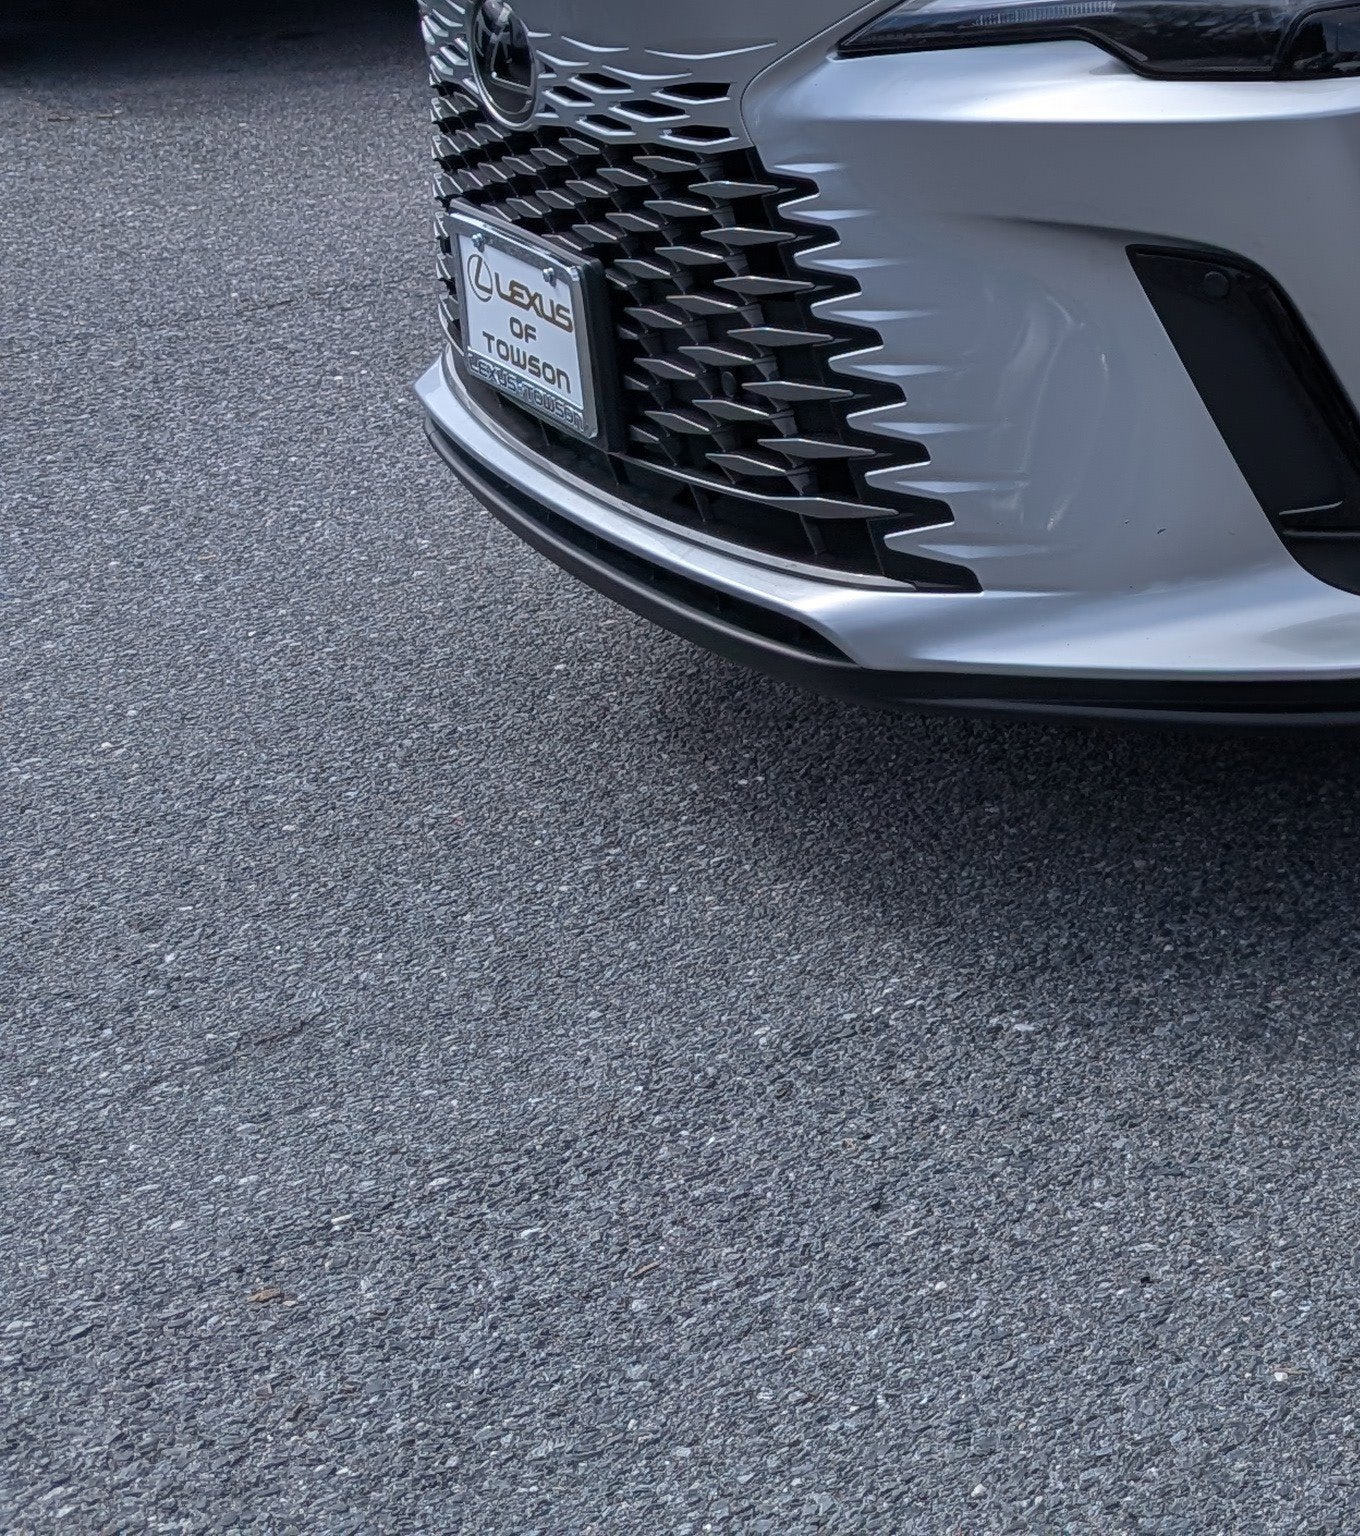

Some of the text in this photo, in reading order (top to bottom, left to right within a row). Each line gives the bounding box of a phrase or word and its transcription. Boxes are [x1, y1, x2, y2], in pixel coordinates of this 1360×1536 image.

[494, 271, 574, 334] LEXUS
[509, 316, 537, 344] OF
[468, 354, 517, 392] LEXUS
